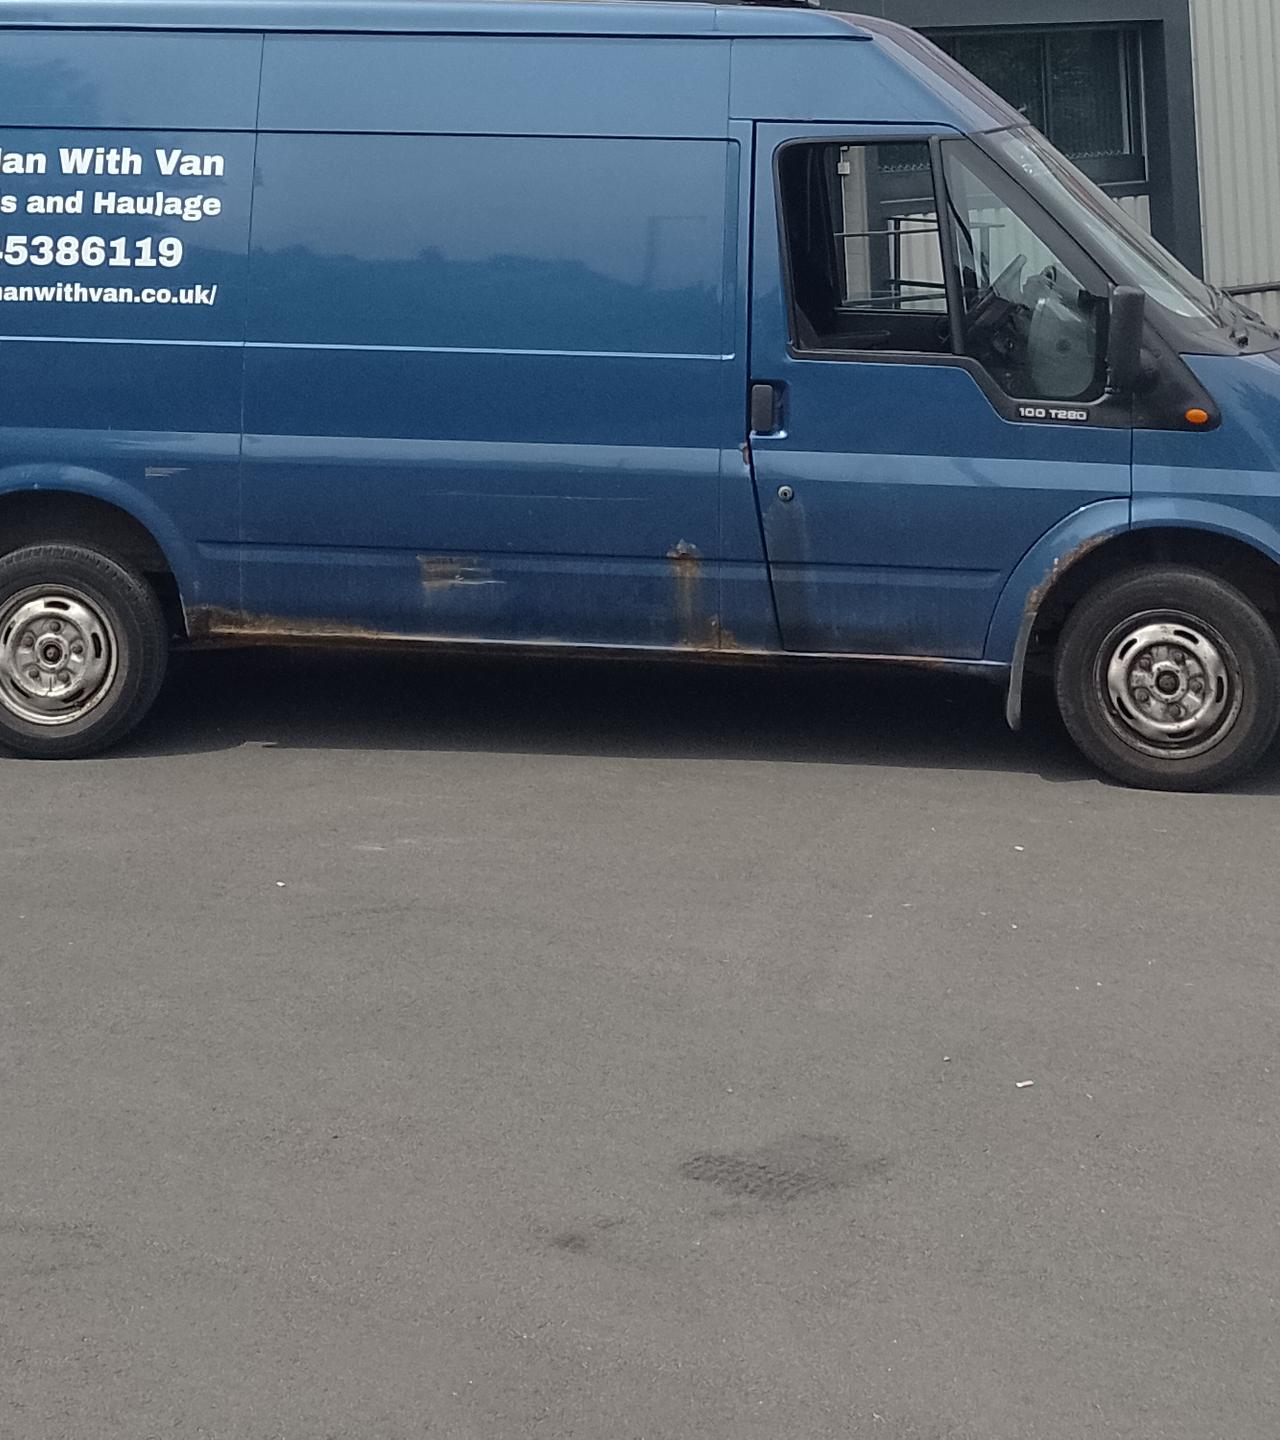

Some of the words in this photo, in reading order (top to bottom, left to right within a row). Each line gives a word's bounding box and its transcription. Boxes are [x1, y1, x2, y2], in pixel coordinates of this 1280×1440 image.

[59, 148, 142, 176] With
[155, 149, 225, 177] Van
[26, 190, 83, 215] and
[93, 191, 222, 221] Haulage
[1019, 407, 1046, 418] 100
[1048, 409, 1087, 420] T280
